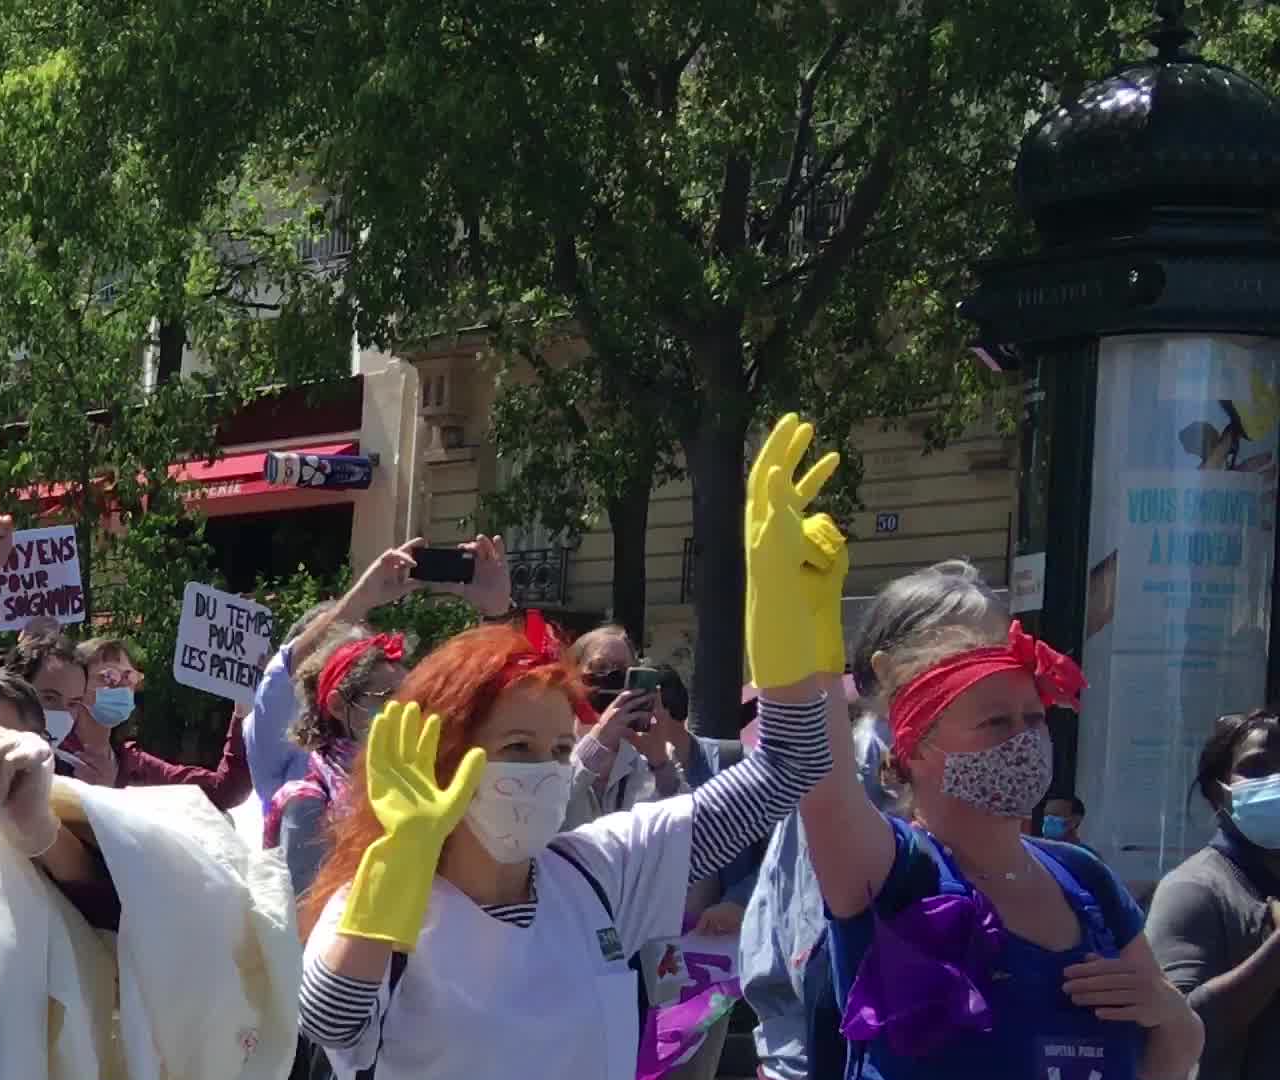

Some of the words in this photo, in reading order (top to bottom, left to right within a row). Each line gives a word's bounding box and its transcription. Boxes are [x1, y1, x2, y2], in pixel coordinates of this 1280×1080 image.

[195, 592, 217, 621] DU
[225, 603, 272, 638] TEMPS
[208, 624, 246, 656] POUR
[181, 643, 208, 673] LES
